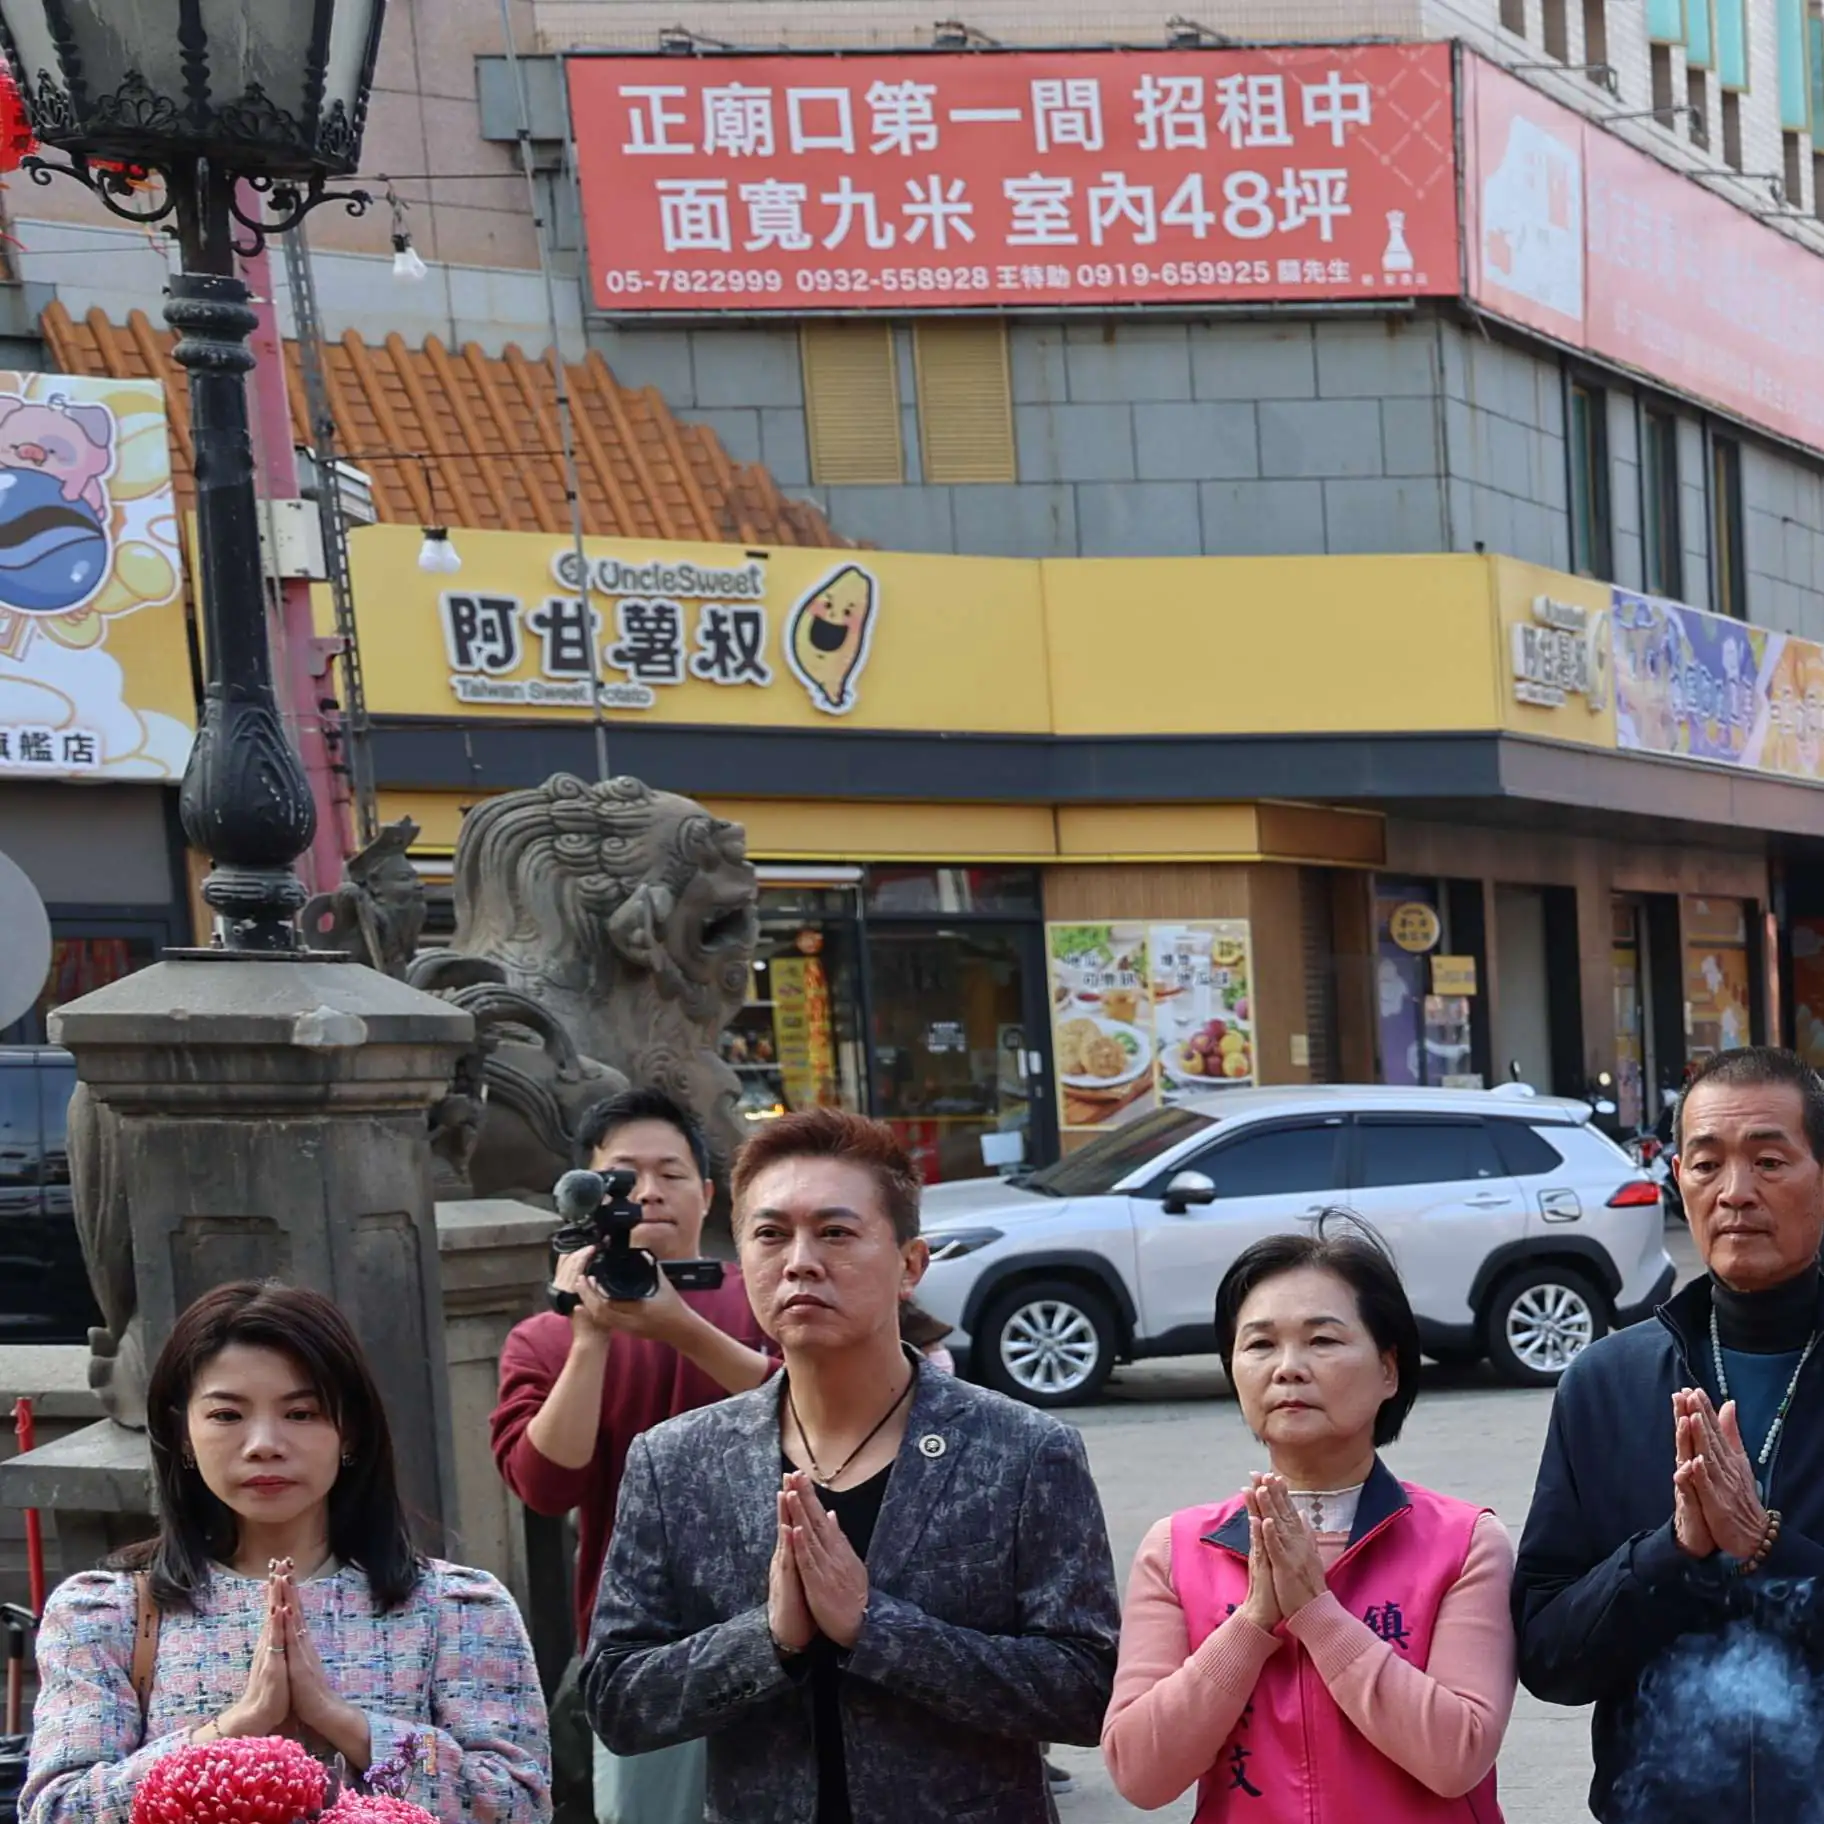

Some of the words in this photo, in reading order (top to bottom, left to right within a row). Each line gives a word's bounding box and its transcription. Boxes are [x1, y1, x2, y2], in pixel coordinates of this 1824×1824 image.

[618, 77, 1105, 157] 正廟口第一間
[1135, 71, 1373, 153] 招租中
[655, 174, 975, 254] 面寬九米
[1003, 166, 1353, 248] 室內48坪
[606, 270, 782, 294] 05-7822999
[796, 266, 990, 292] 0932-558928
[1076, 259, 1269, 288] 0919-659925
[600, 560, 763, 597] UncleSweet
[447, 595, 771, 686] 阿甘薯叔
